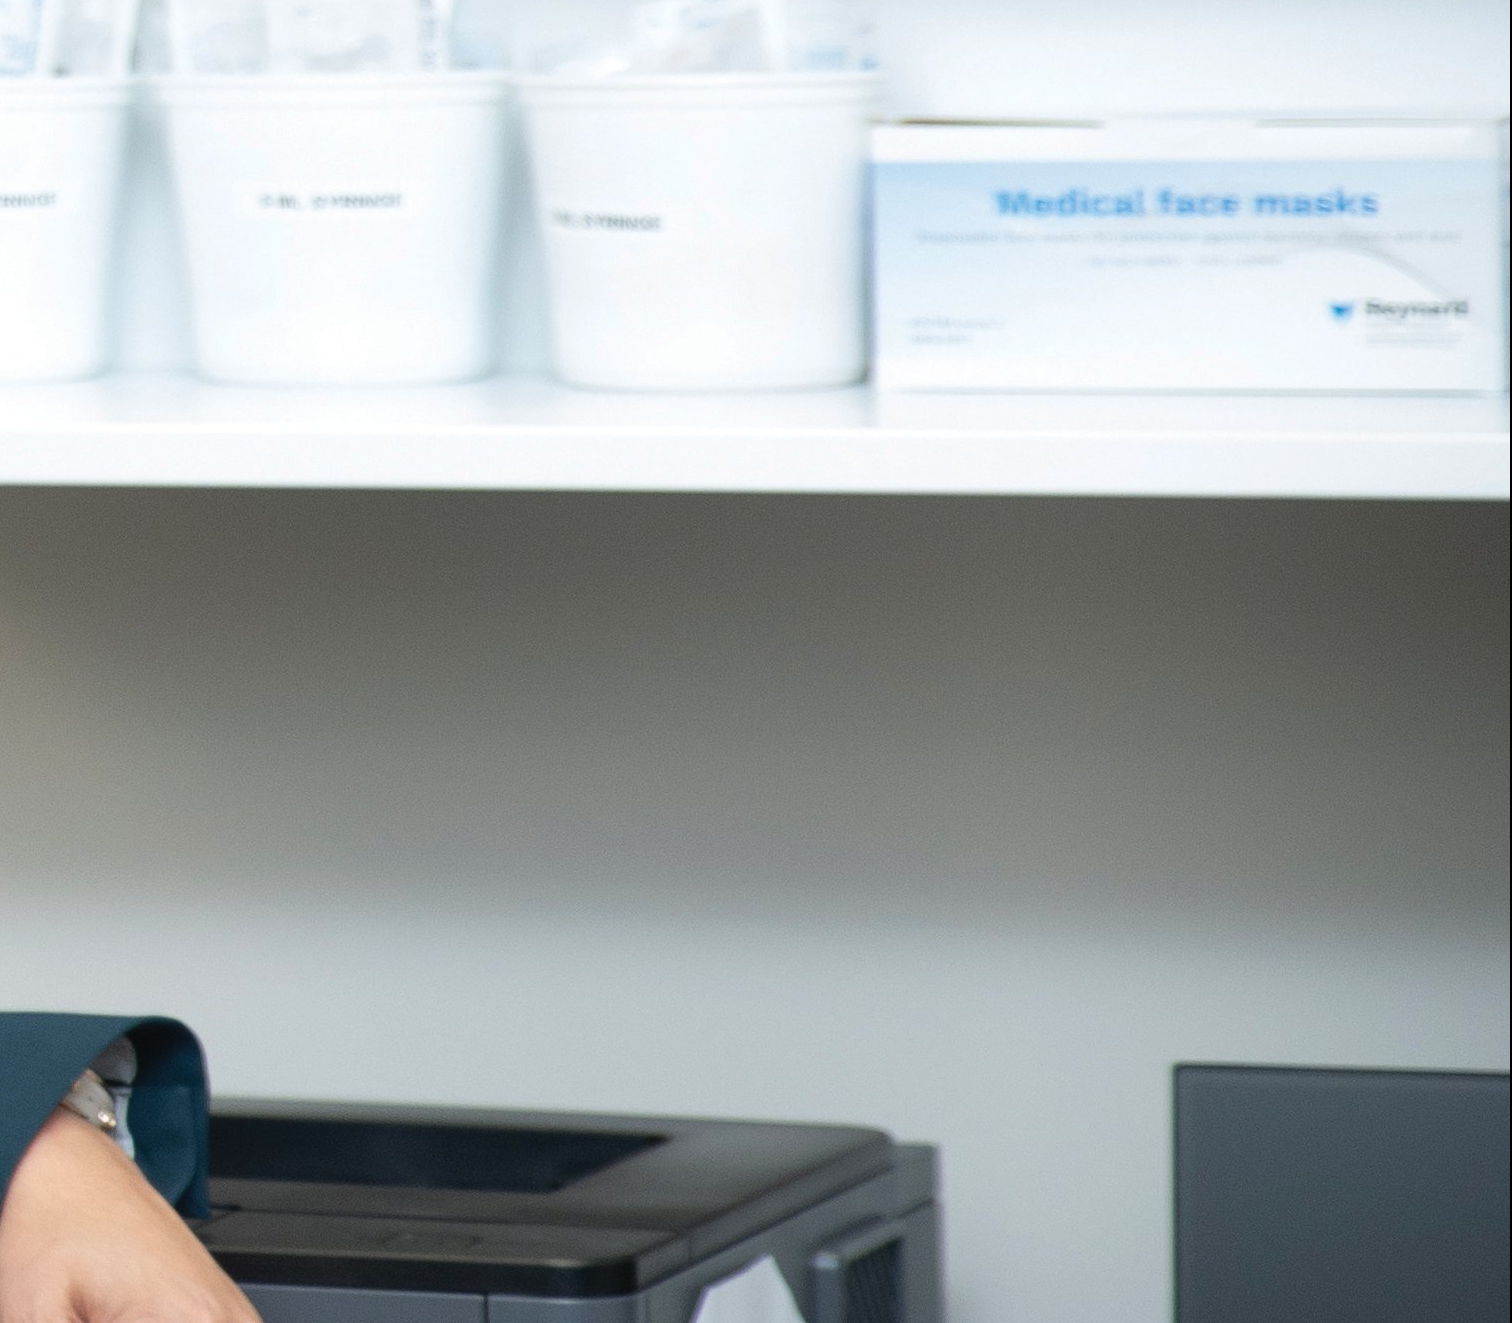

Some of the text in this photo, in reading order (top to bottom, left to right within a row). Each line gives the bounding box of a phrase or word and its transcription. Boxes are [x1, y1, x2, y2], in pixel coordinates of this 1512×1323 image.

[992, 185, 1383, 219] Medical face masks
